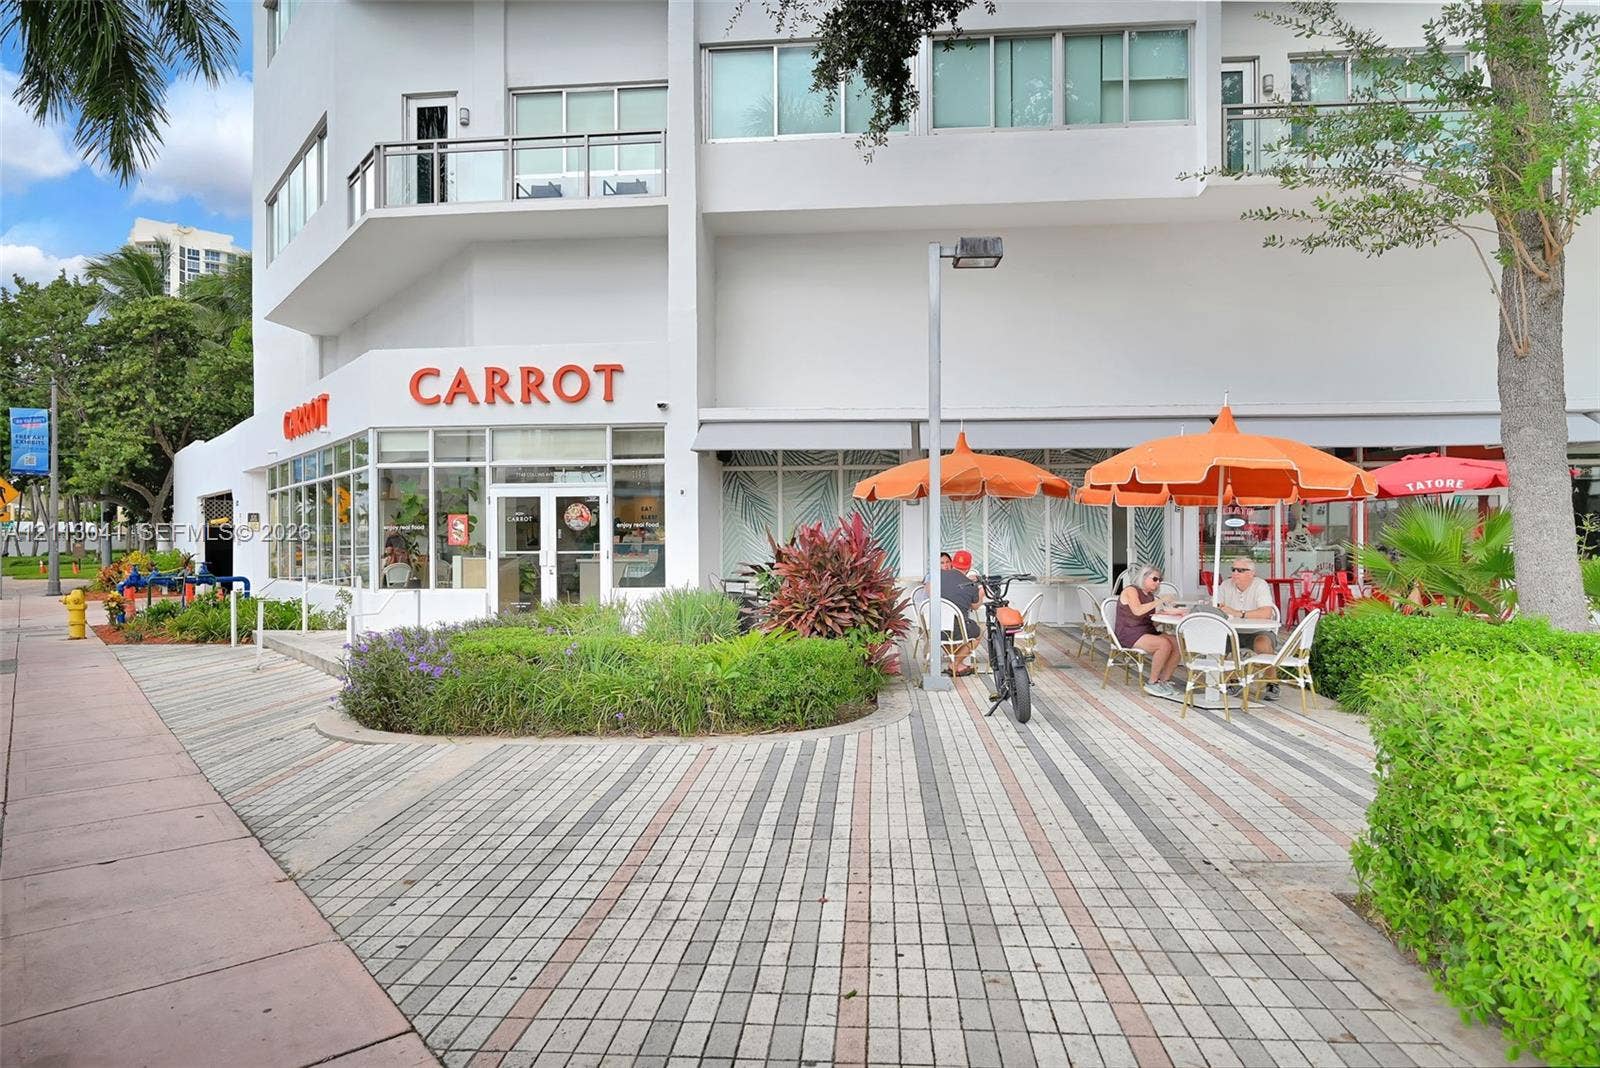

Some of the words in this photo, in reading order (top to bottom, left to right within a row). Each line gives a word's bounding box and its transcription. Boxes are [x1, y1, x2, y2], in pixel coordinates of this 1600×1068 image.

[409, 364, 625, 405] CARROT
[283, 393, 330, 440] CARROT
[1405, 478, 1465, 492] TATORE
